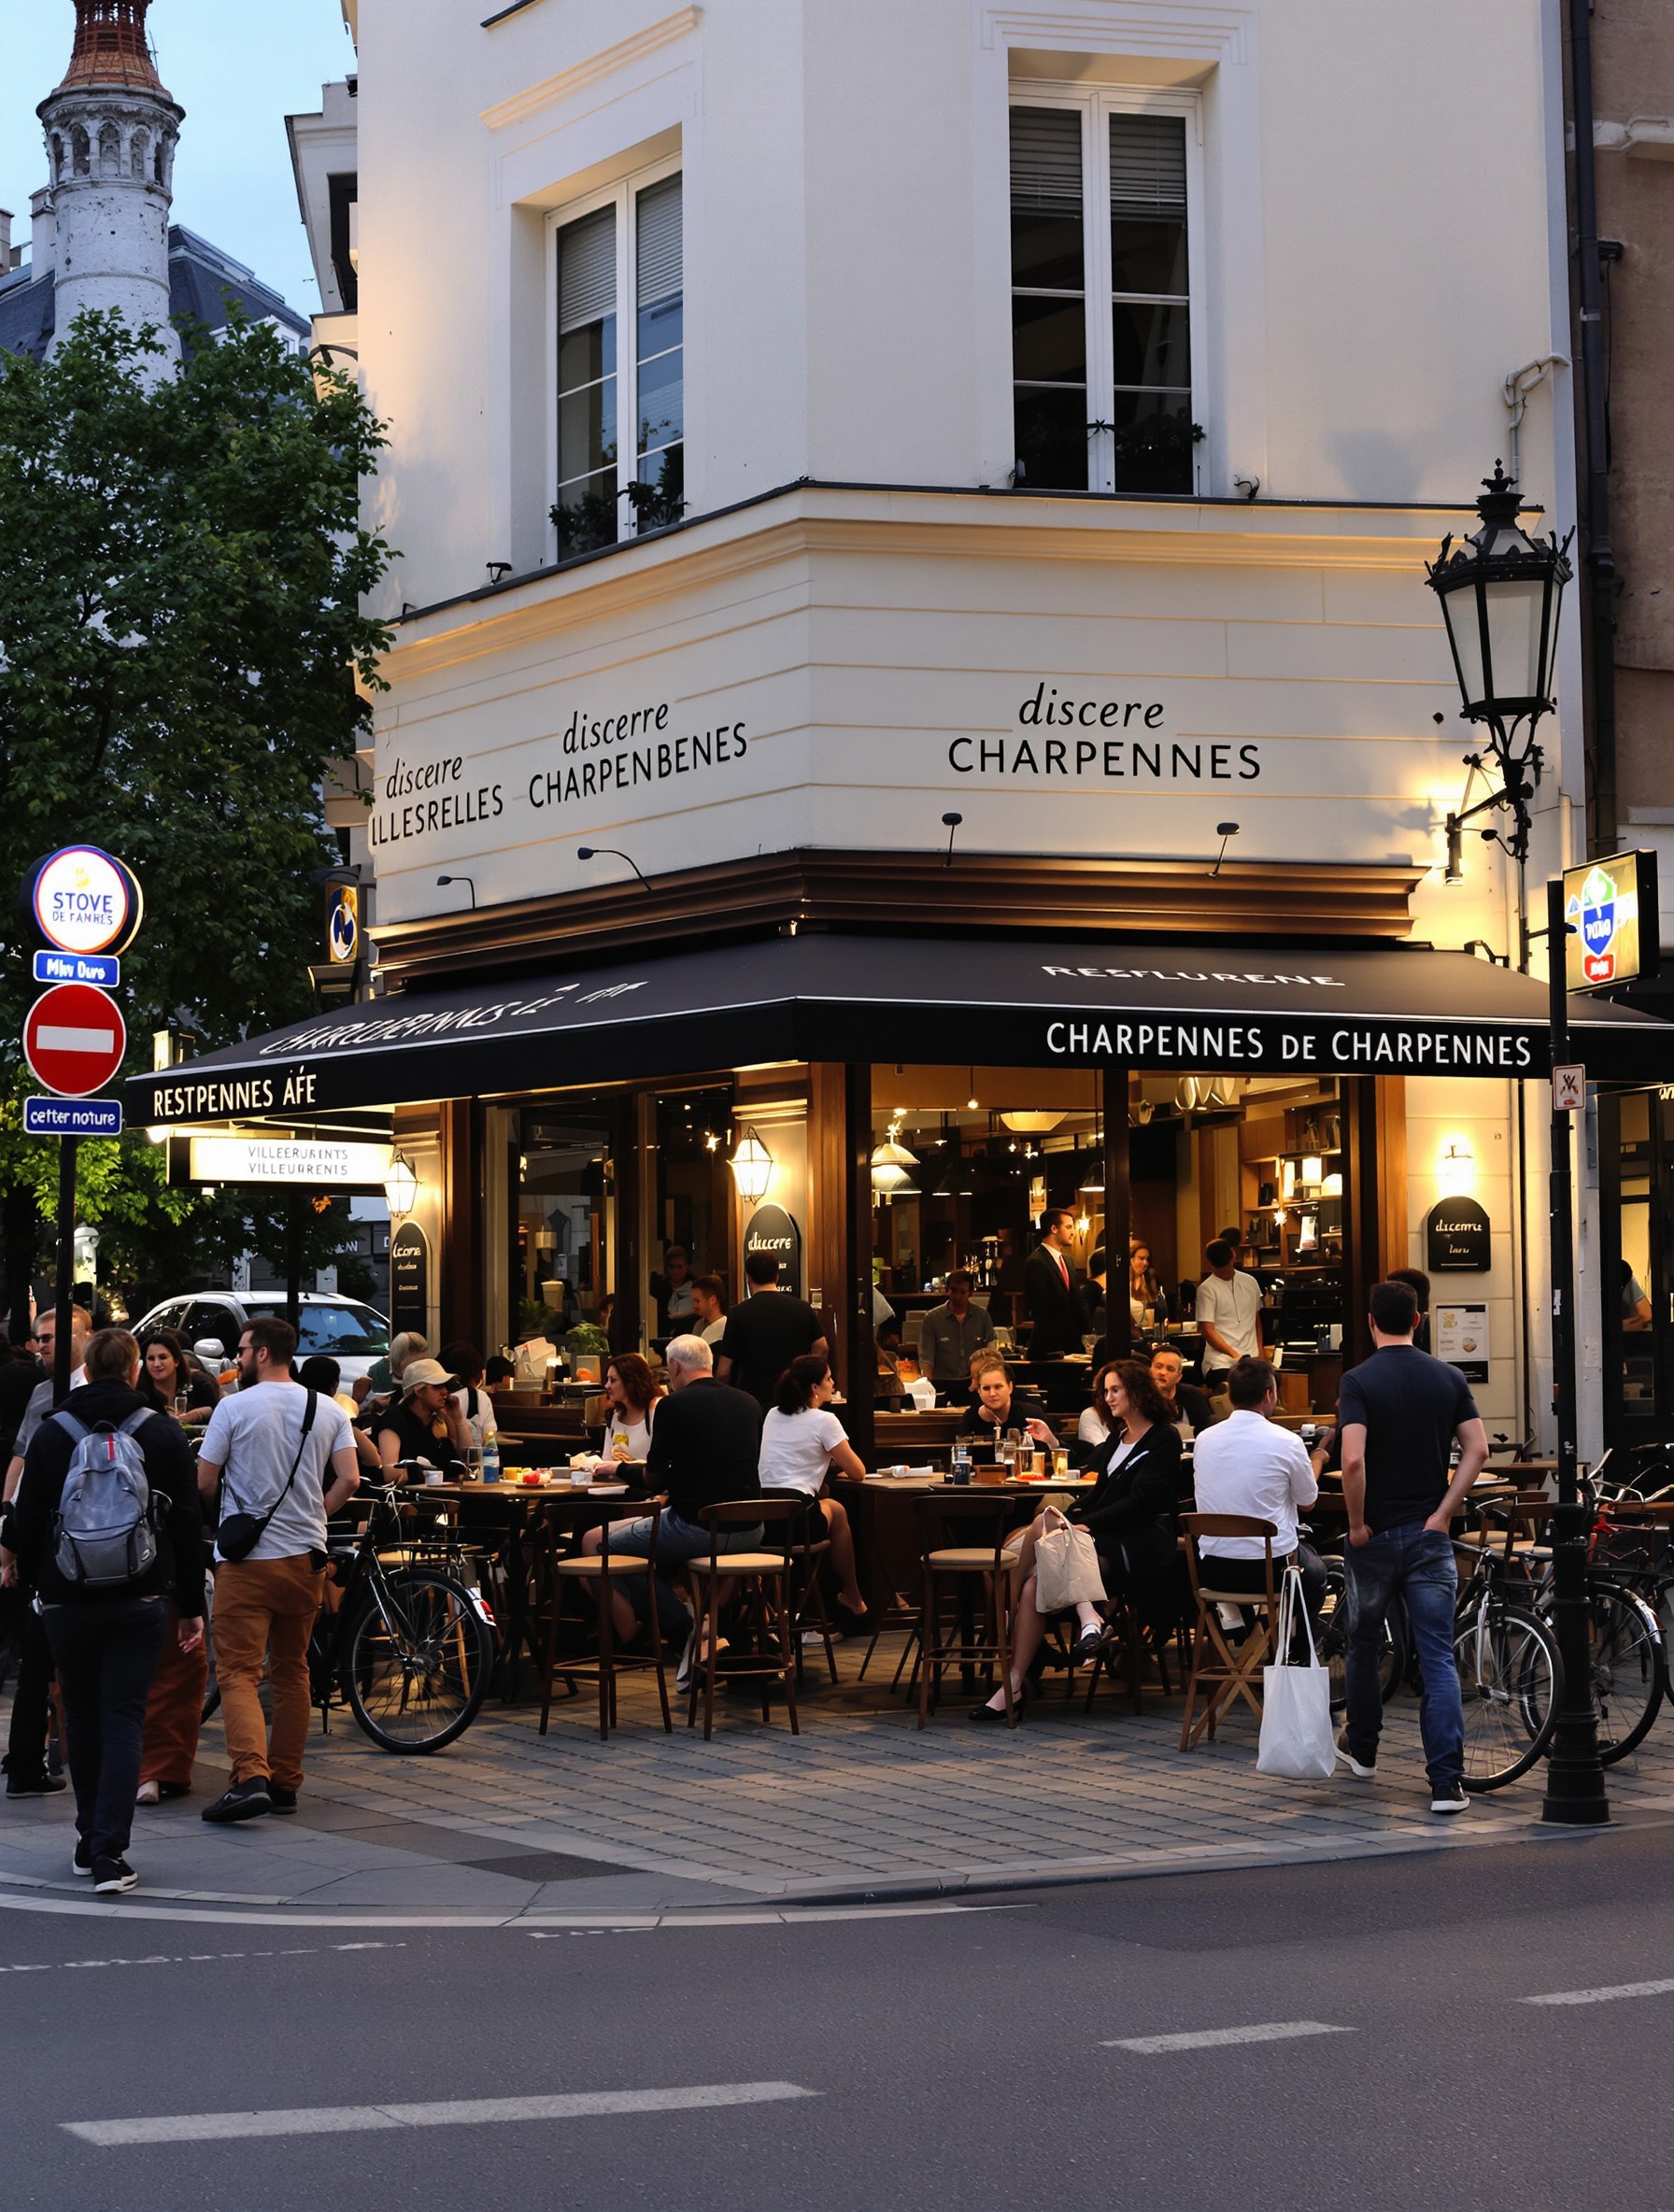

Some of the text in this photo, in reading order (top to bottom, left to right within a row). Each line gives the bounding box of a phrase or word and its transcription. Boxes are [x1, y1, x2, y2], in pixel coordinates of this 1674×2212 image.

[1018, 682, 1165, 729] discere
[562, 702, 669, 755] discerre
[528, 722, 748, 808] CHARPENBENES
[948, 737, 1261, 780] CHARPENNES
[53, 891, 113, 913] STOVE
[1046, 1022, 1532, 1066] CHARPENNES DE CHARPENNES
[153, 1080, 274, 1117] RESTPENNES
